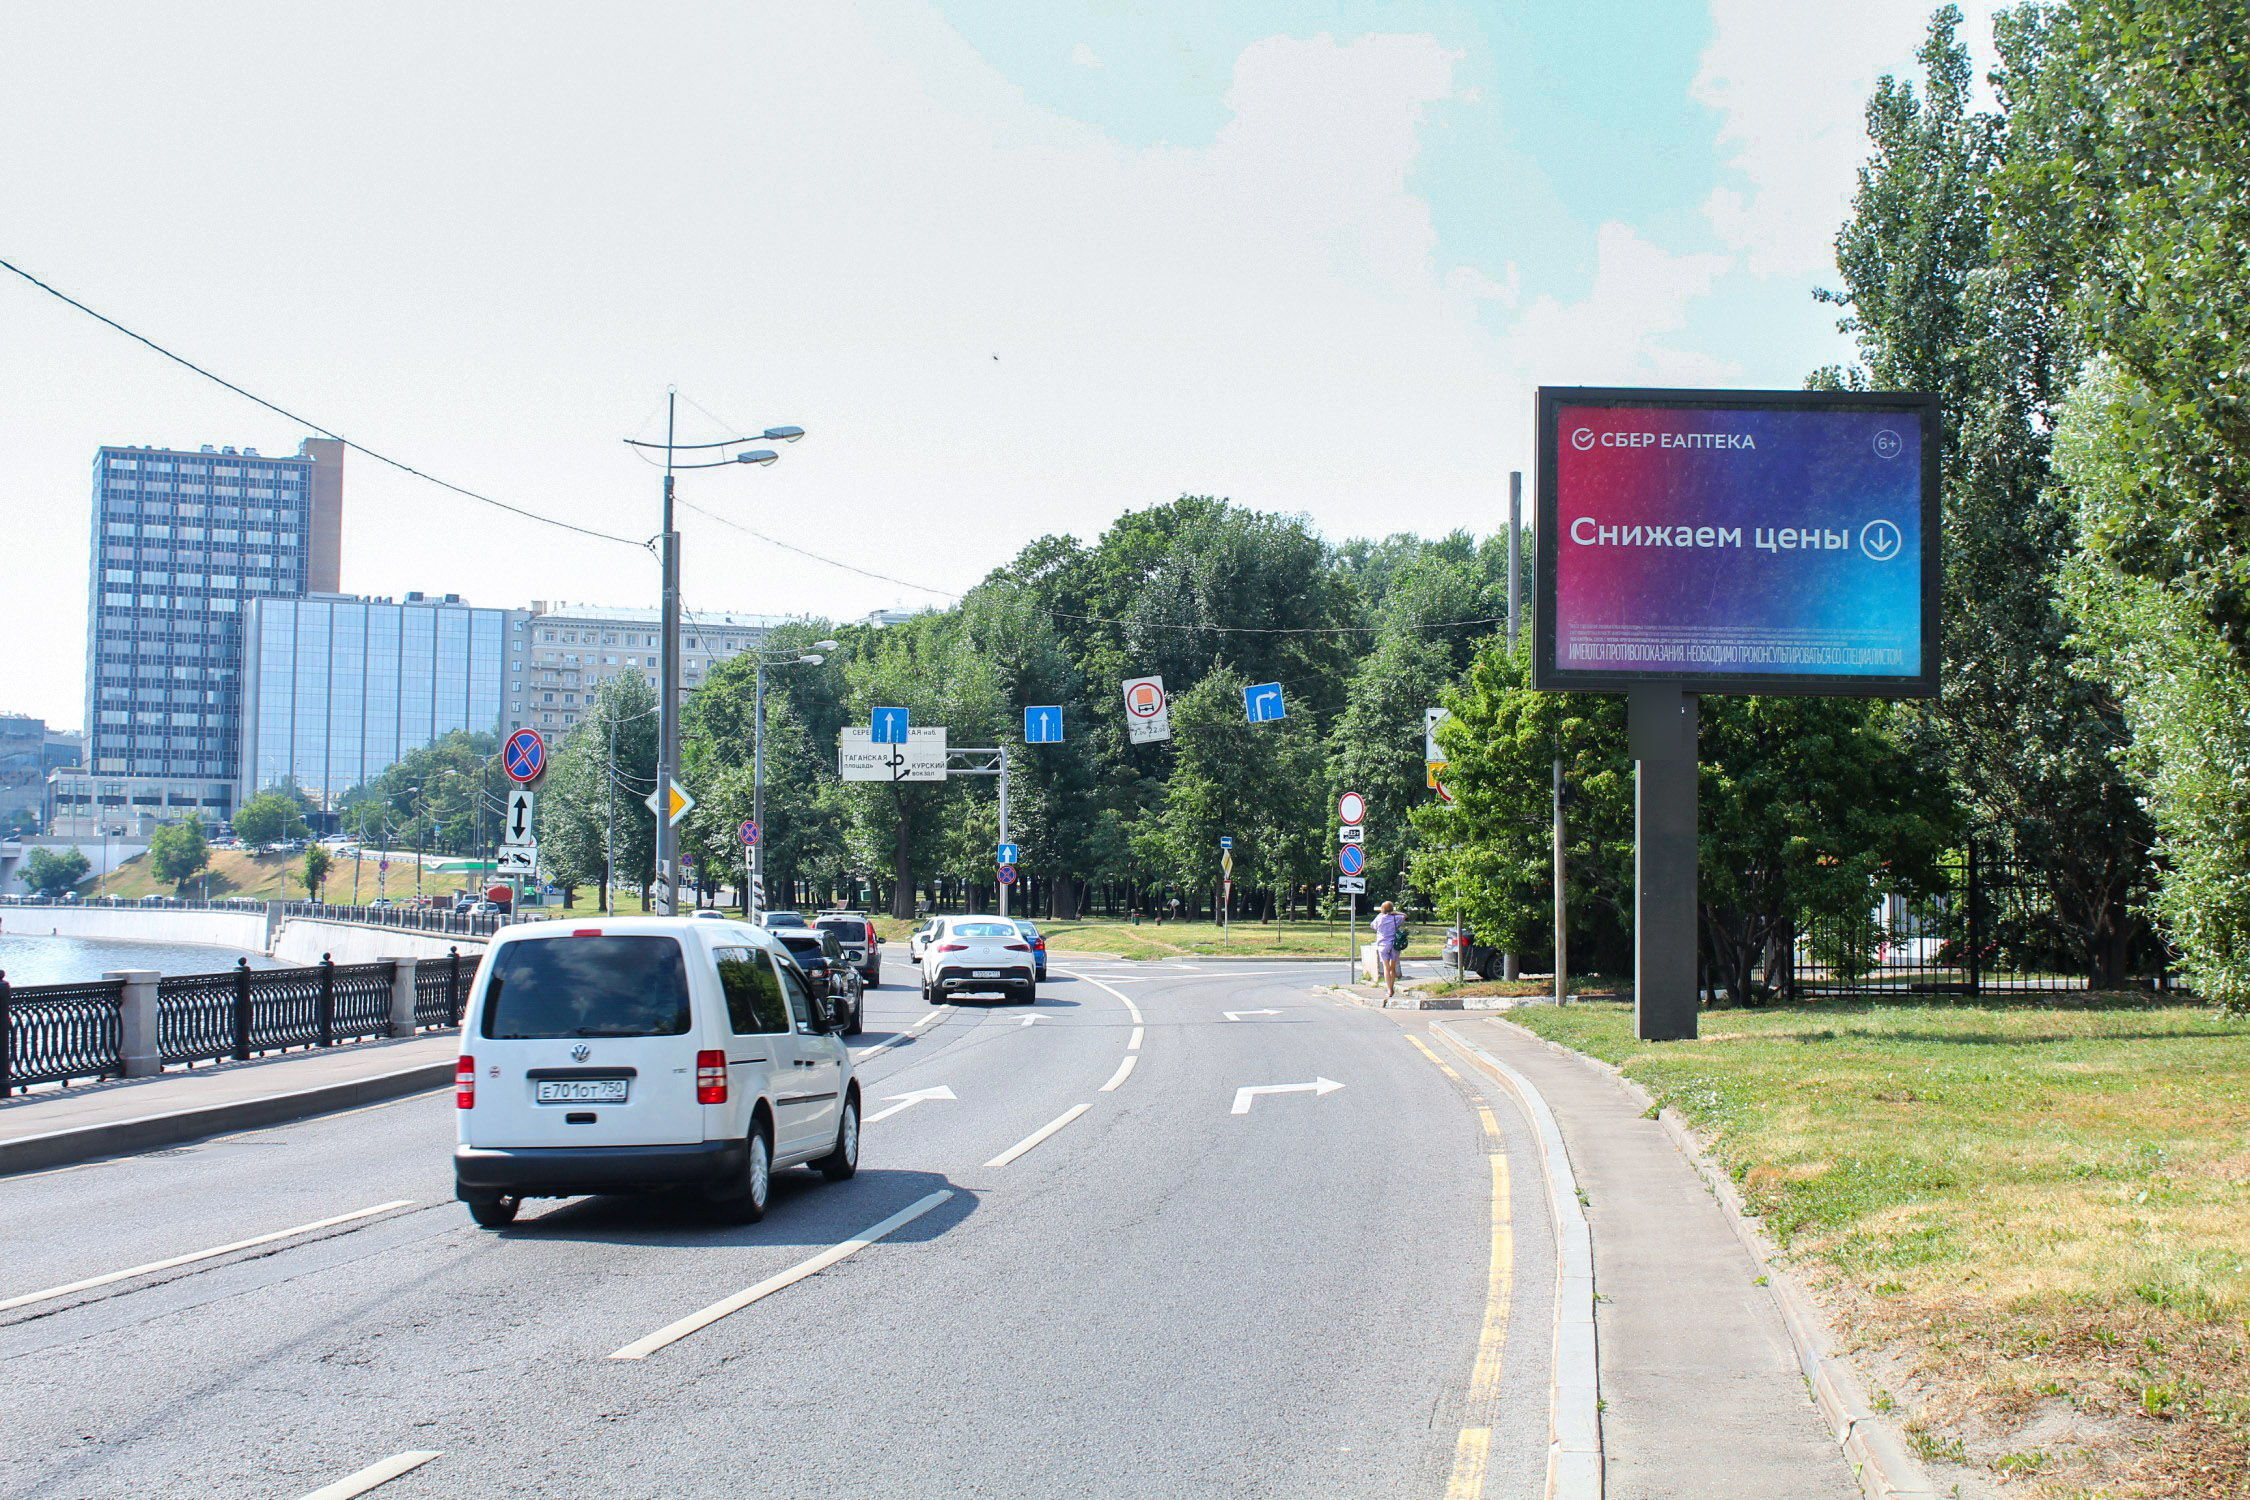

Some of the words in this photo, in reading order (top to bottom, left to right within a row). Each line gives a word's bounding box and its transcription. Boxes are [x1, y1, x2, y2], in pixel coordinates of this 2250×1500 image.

[1600, 431, 1656, 449] СБЕР
[1660, 432, 1756, 450] ЕАПТЕКА
[1878, 437, 1896, 450] 6+
[1569, 516, 1742, 549] Снижаем
[1754, 526, 1850, 553] цены
[1568, 643, 1606, 661] ИМЕЮТСЯ
[1606, 644, 1686, 663] ПРОТИВОПОКАЗАНИЯ.
[1686, 645, 1738, 666] НЕОБХОДИМО
[1738, 646, 1831, 665] ПРОКОНСУЛЬТИРОВАТЬСЯ
[844, 754, 888, 762] ТАГАНСКАЯ
[911, 760, 945, 769] КУРСКИЙ
